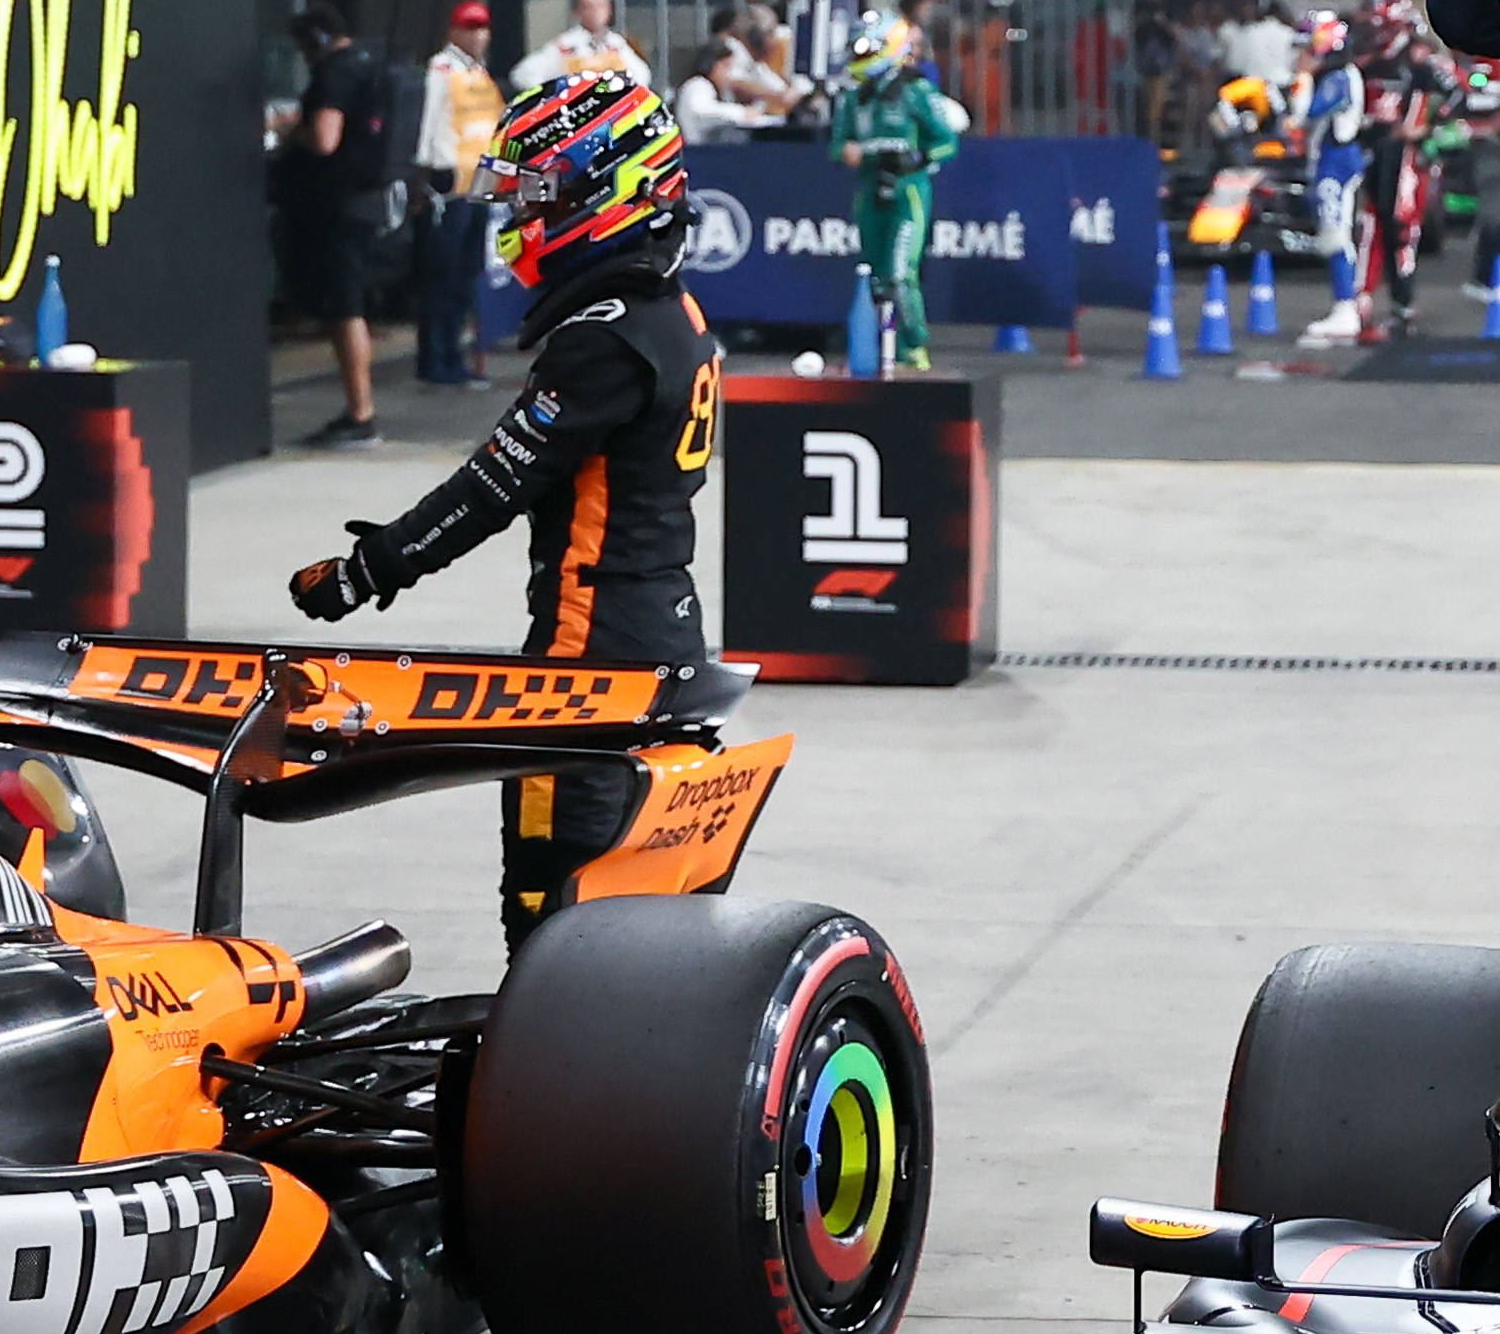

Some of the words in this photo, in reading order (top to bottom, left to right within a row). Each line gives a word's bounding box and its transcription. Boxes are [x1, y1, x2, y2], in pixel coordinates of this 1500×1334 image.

[926, 210, 1027, 261] RMÉ
[802, 430, 909, 565] 1
[408, 670, 616, 721] OKX
[666, 765, 762, 813] Dropbox
